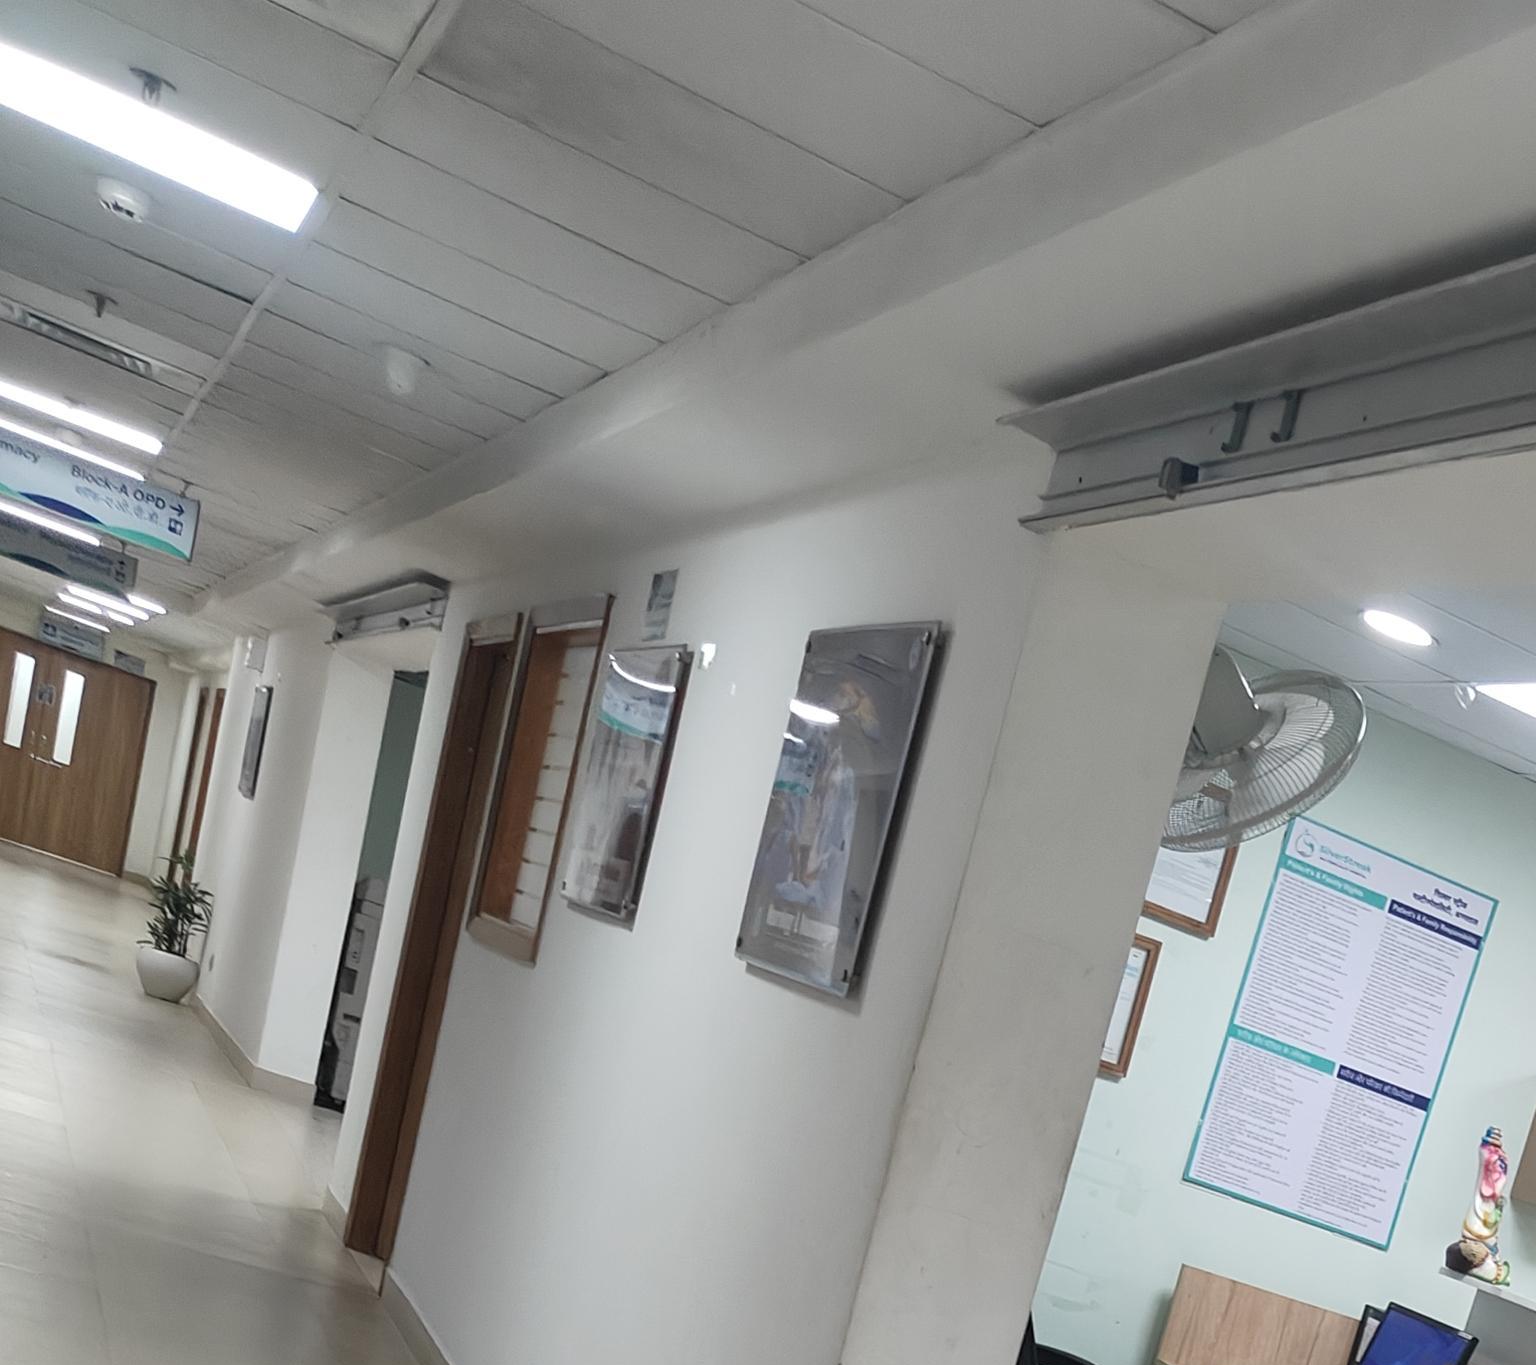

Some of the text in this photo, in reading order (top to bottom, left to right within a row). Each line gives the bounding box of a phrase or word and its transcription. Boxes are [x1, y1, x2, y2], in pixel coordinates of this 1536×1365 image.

[71, 465, 129, 497] Block-A
[133, 489, 166, 510] OPD
[1420, 915, 1440, 930] Family
